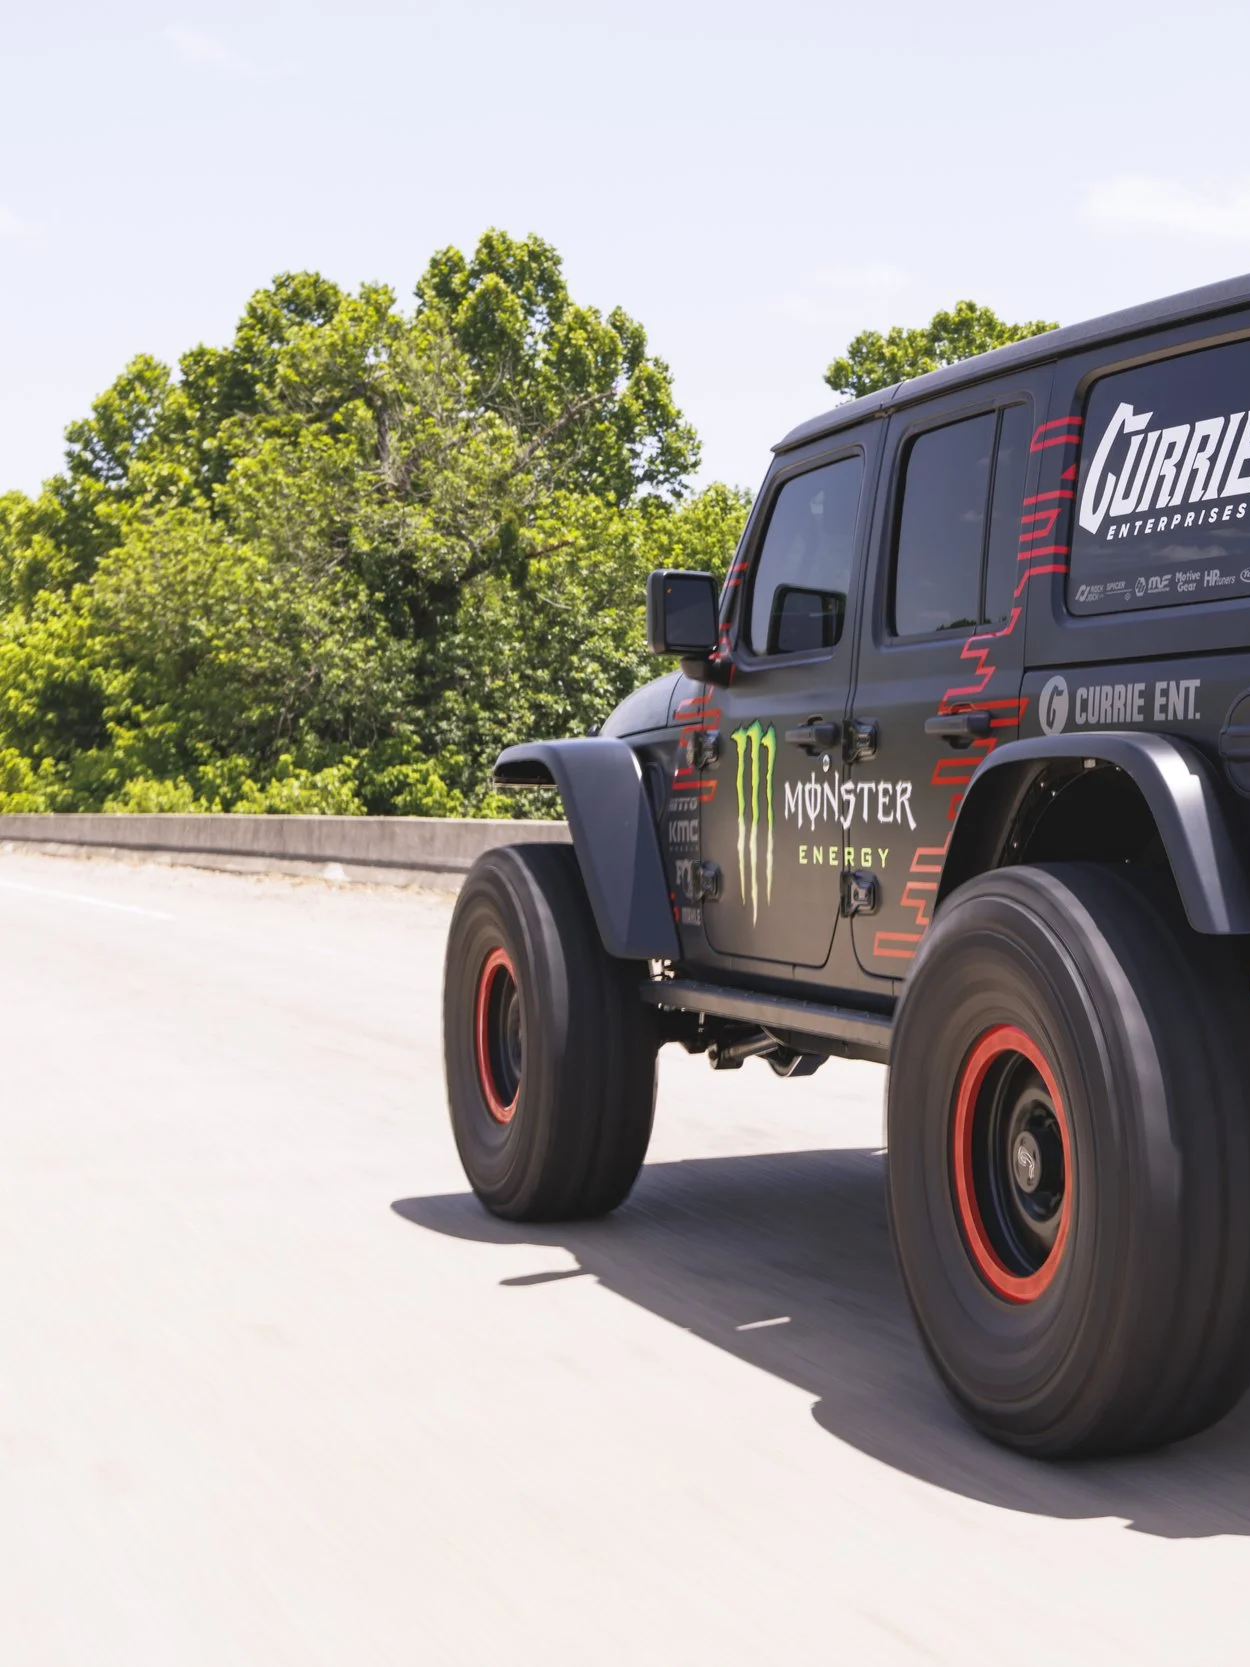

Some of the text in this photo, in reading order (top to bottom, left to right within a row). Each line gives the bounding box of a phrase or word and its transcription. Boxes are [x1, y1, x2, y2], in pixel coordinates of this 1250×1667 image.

[1106, 502, 1247, 540] ENTERPRISES
[1175, 570, 1201, 583] Motive
[1177, 582, 1197, 593] Gear
[1075, 682, 1146, 725] CURRIE
[1153, 679, 1201, 721] ENT.
[784, 770, 917, 832] MONSTER
[669, 819, 699, 843] KMC
[799, 844, 889, 868] ENERGY
